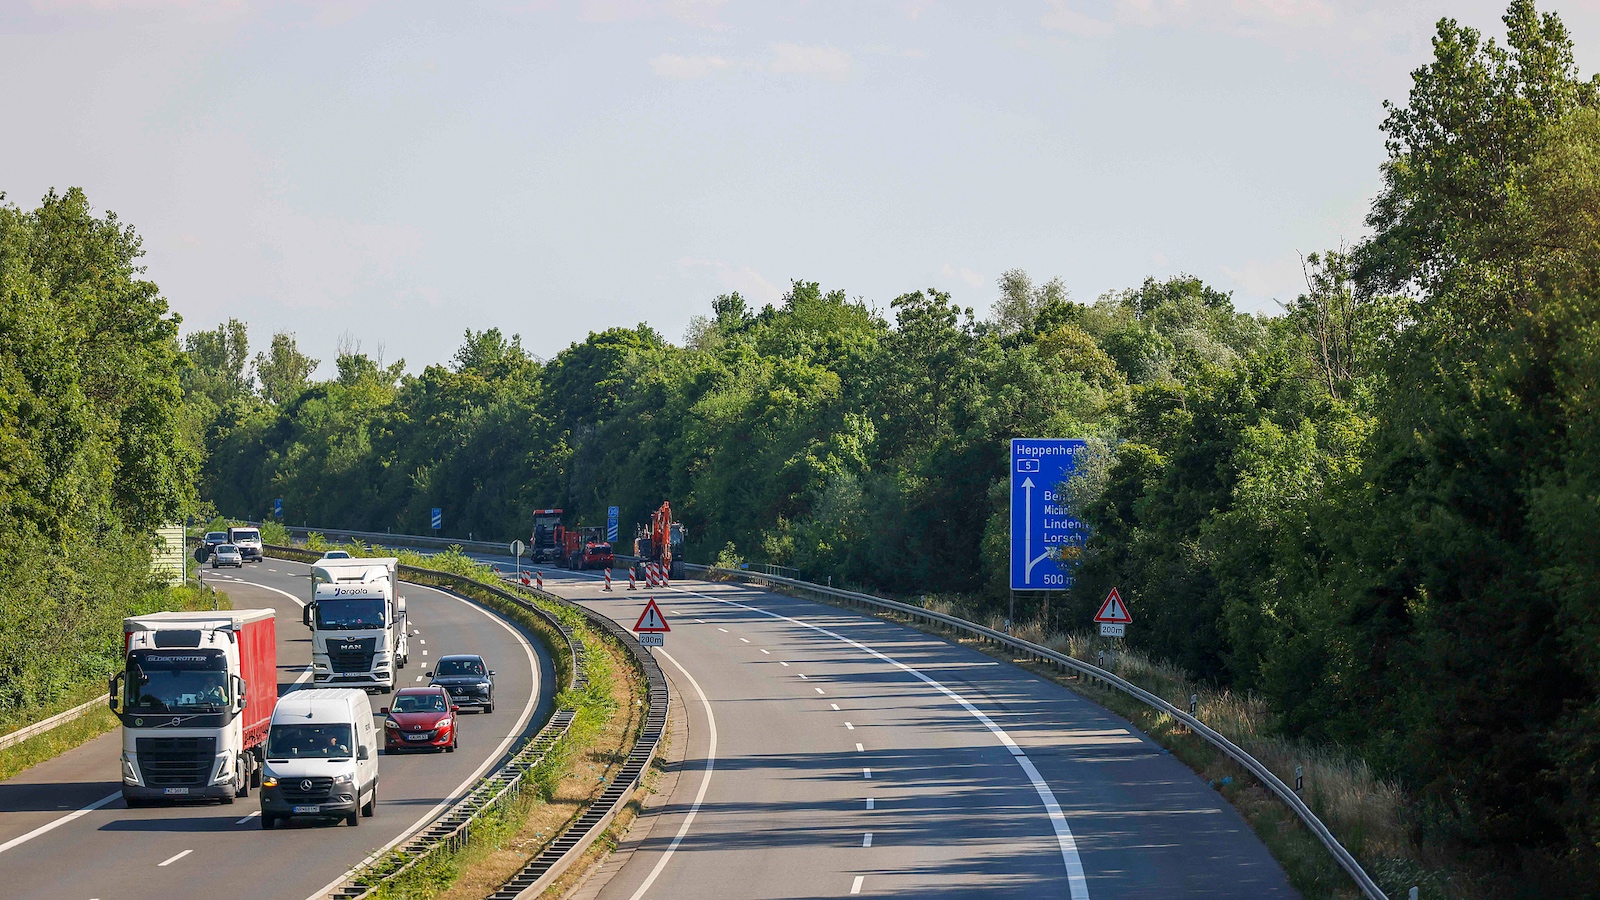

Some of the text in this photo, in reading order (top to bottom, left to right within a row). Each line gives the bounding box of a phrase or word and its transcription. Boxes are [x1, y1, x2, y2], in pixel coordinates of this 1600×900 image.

[1025, 461, 1031, 470] 5
[1043, 532, 1082, 543] Lorsch
[1043, 574, 1064, 585] 500
[1102, 626, 1123, 634] 200m
[146, 654, 207, 662] GLOBETROTTER
